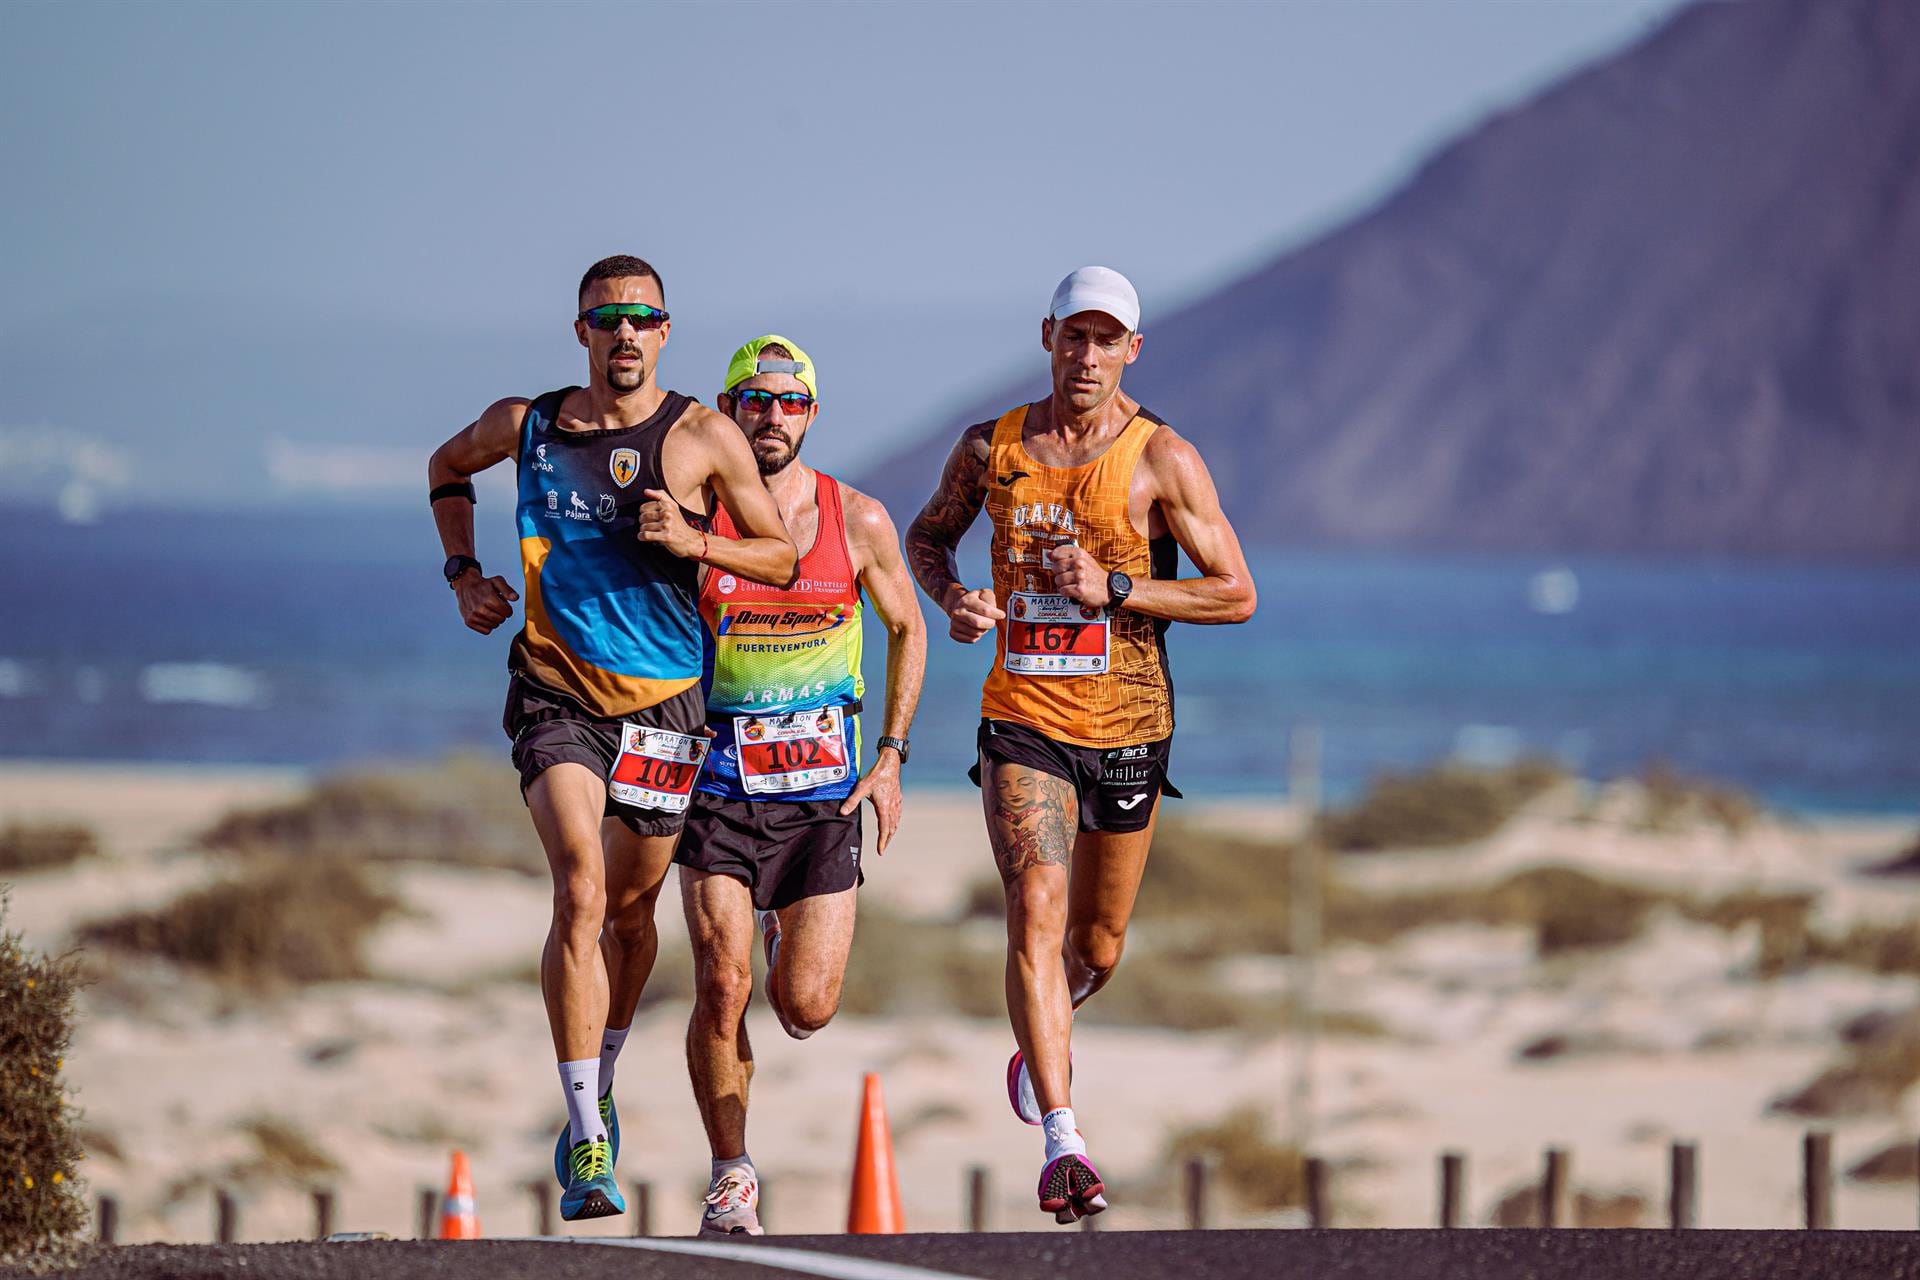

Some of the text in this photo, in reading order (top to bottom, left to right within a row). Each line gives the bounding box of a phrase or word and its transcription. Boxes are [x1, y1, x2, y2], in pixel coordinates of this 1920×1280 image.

[565, 510, 590, 520] Pájara
[1013, 502, 1080, 535] U.A.V.A.
[1031, 597, 1072, 606] MARATO
[735, 610, 828, 630] Dany Sport
[736, 638, 827, 653] FUERTEVENTURA
[1024, 624, 1081, 651] 167
[742, 681, 826, 703] ARMAS
[766, 738, 822, 770] 102
[636, 758, 683, 789] 101
[1103, 765, 1148, 781] Müller
